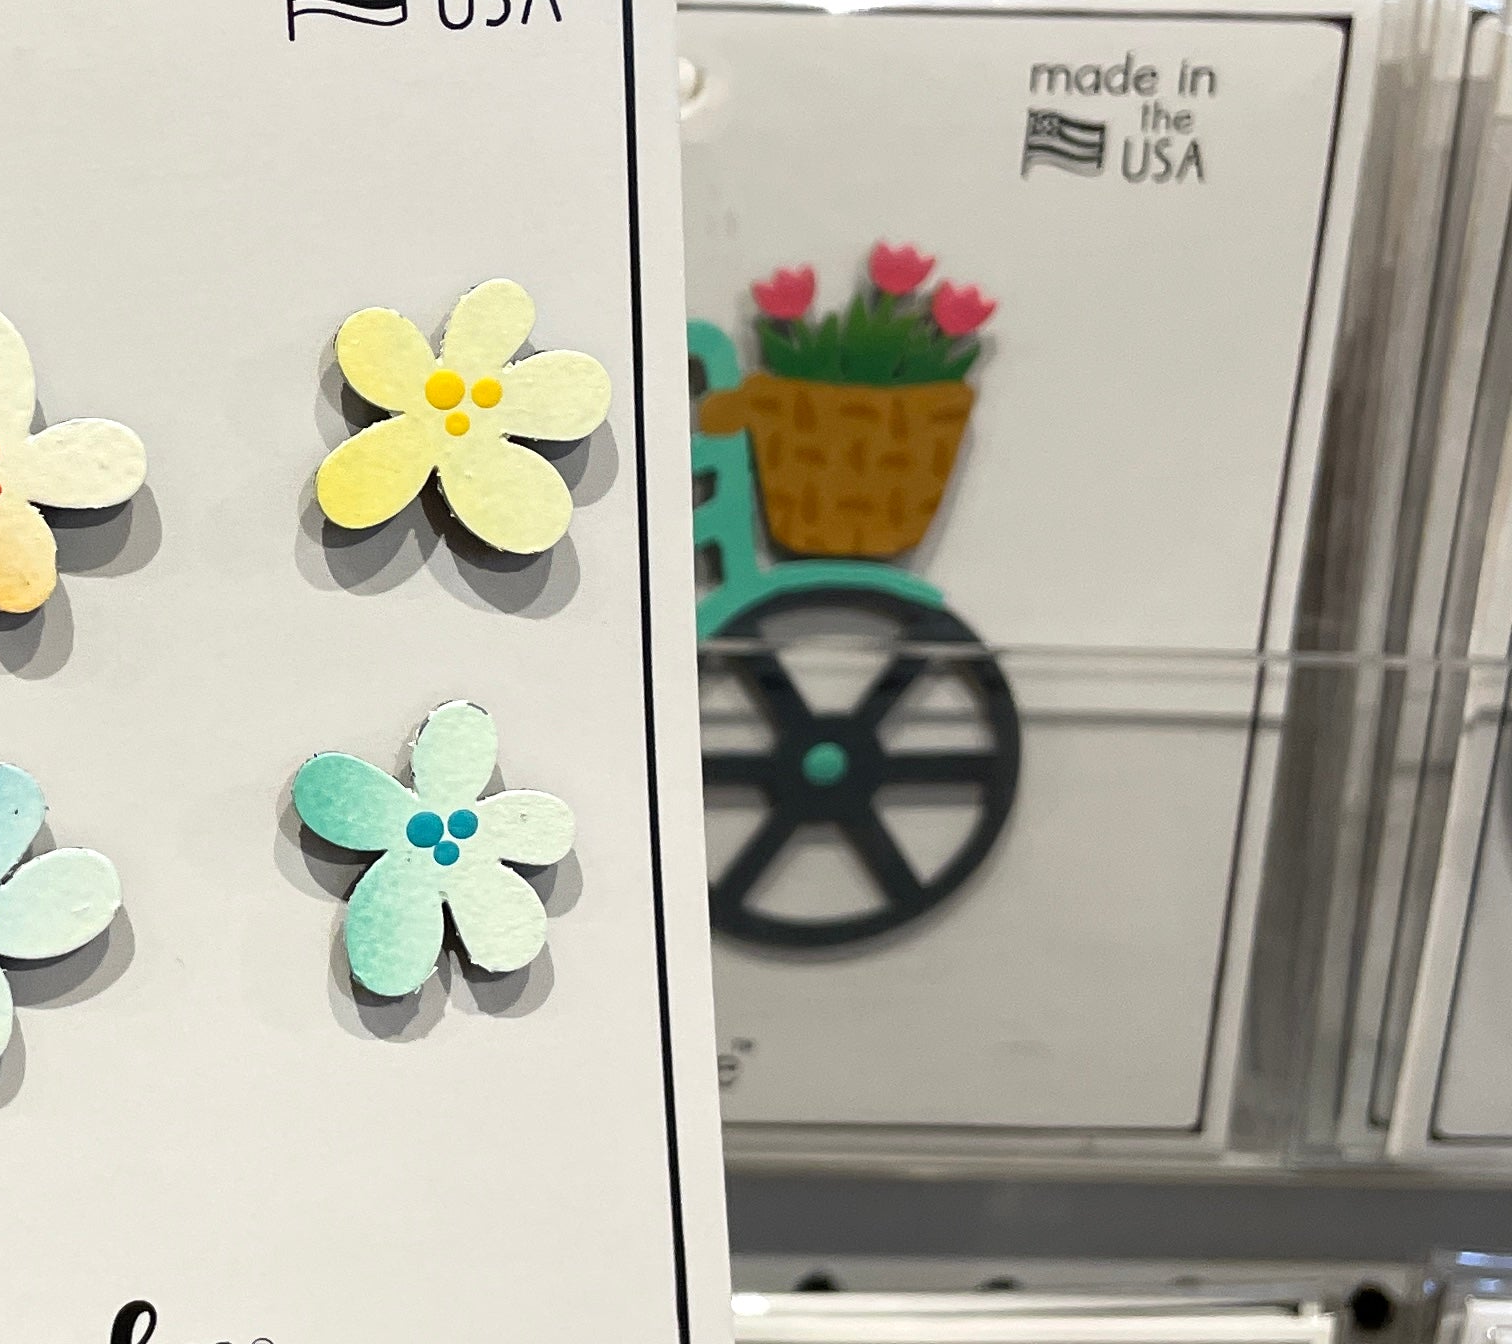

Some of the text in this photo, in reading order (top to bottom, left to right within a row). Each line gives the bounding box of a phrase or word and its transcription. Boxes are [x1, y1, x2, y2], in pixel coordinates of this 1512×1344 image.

[1029, 49, 1218, 98] made in
[1141, 99, 1194, 134] the
[1121, 136, 1206, 184] USA
